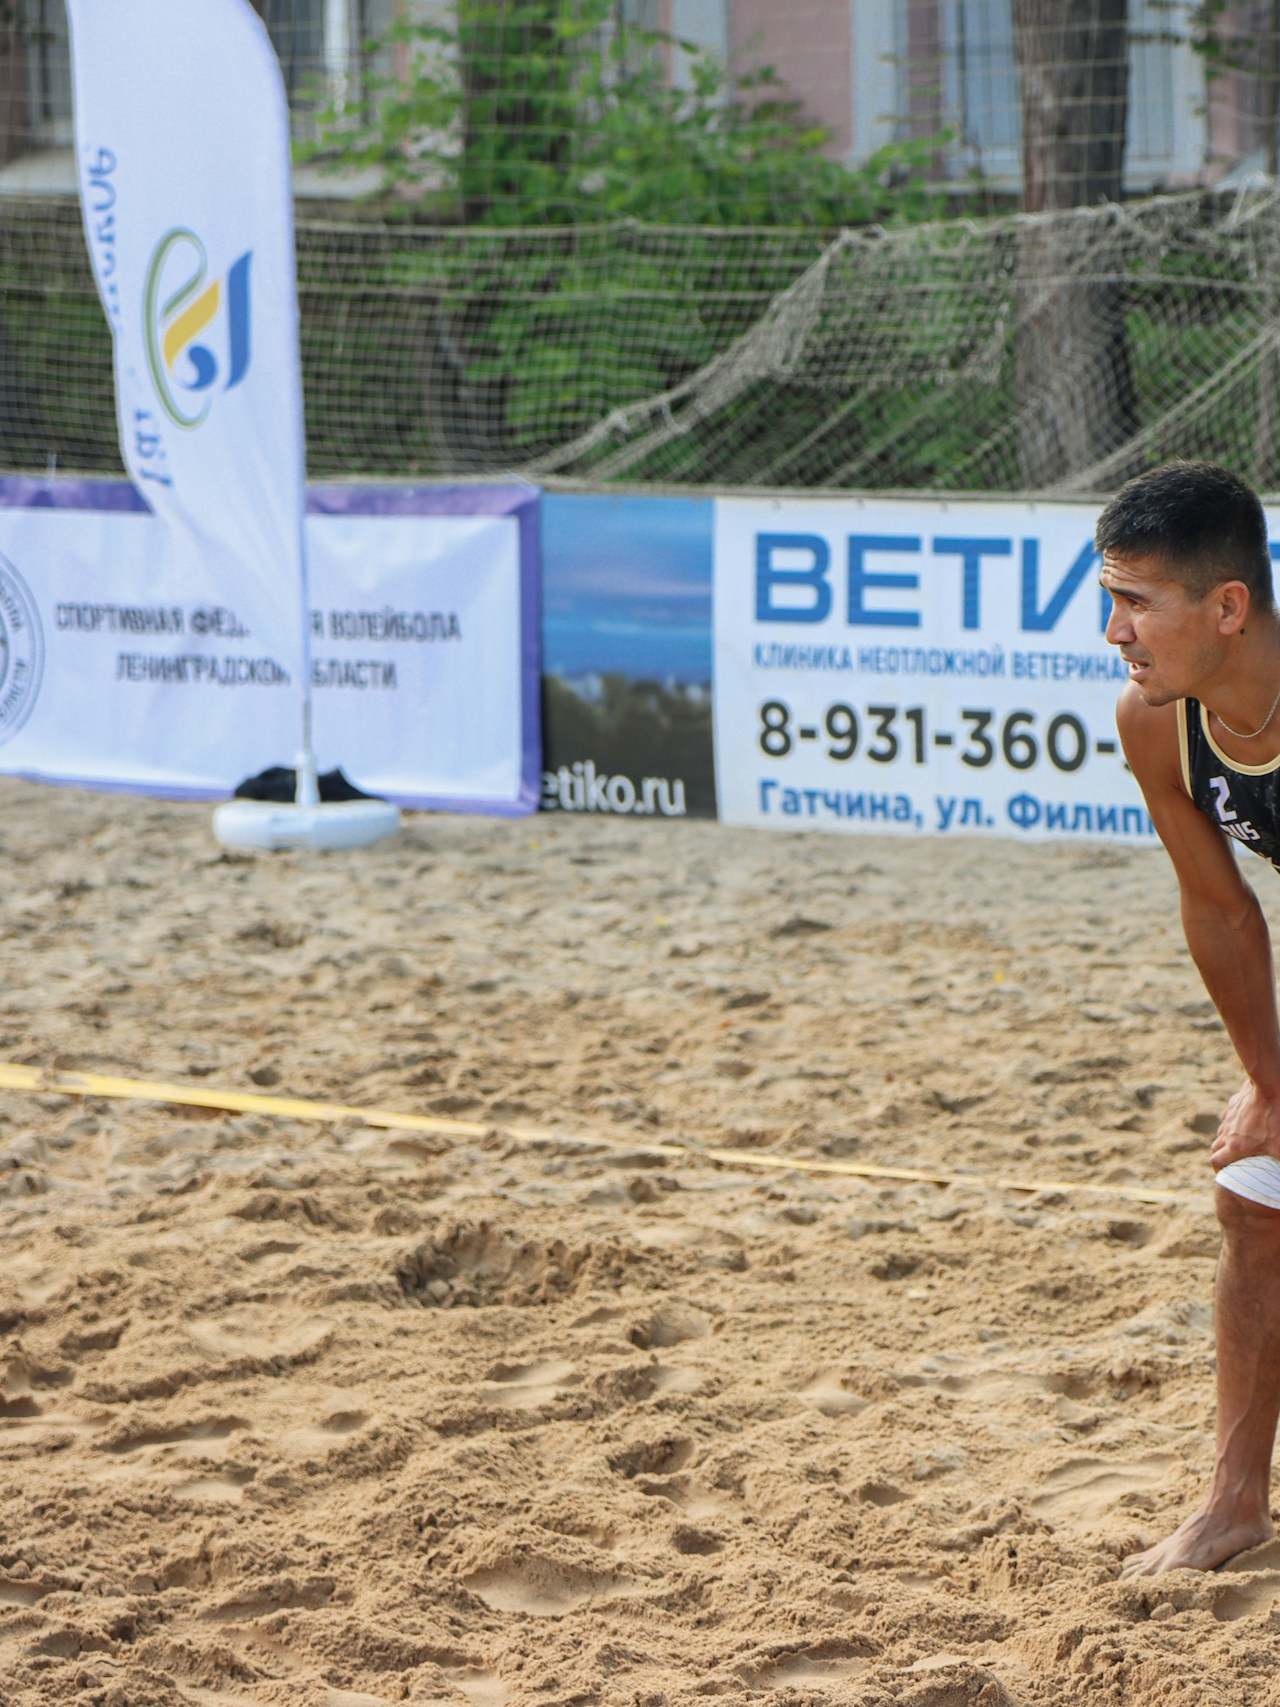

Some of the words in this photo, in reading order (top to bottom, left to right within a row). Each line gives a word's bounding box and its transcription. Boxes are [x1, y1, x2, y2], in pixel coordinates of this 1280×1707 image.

[56, 602, 184, 634] СПОРТИВНАЯ
[329, 604, 462, 641] ВОЛЕЙБОЛА
[311, 657, 397, 688] БЛАСТИ
[753, 641, 853, 672] КЛИНИКА
[858, 645, 1005, 678] НЕОТЛОЖНОЙ
[759, 702, 1134, 774] 8-931-360-
[541, 759, 686, 816] etiko.ru
[758, 779, 924, 827] Гатчина,
[935, 797, 996, 830] ул.
[1209, 776, 1237, 822] 2
